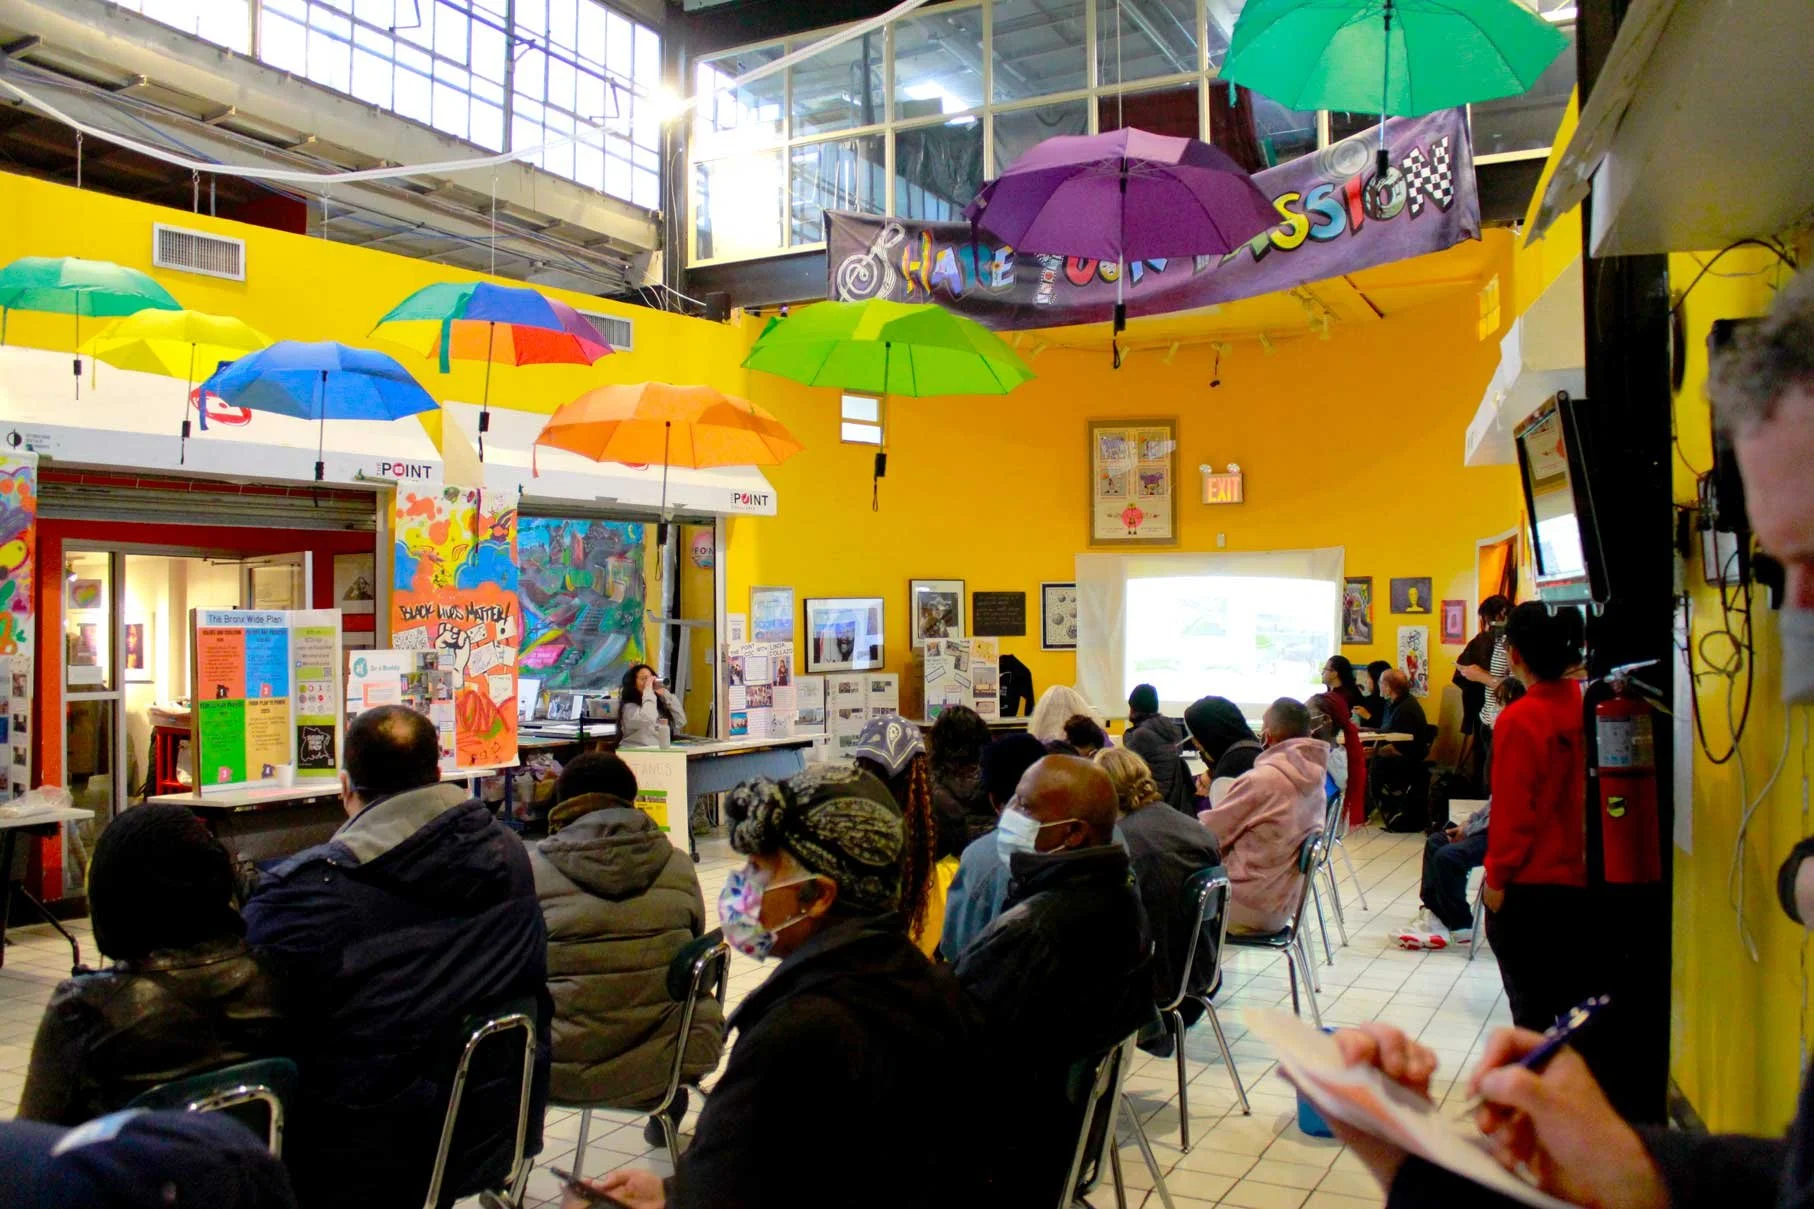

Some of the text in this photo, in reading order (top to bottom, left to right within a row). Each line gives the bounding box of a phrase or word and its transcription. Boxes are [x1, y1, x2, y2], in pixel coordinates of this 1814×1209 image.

[1194, 135, 1454, 274] SSION
[382, 462, 432, 479] POINT
[1207, 477, 1240, 503] EXIT
[734, 492, 769, 506] POINT
[208, 614, 282, 624] The Bronx Wide Plan
[399, 603, 435, 621] BLACK
